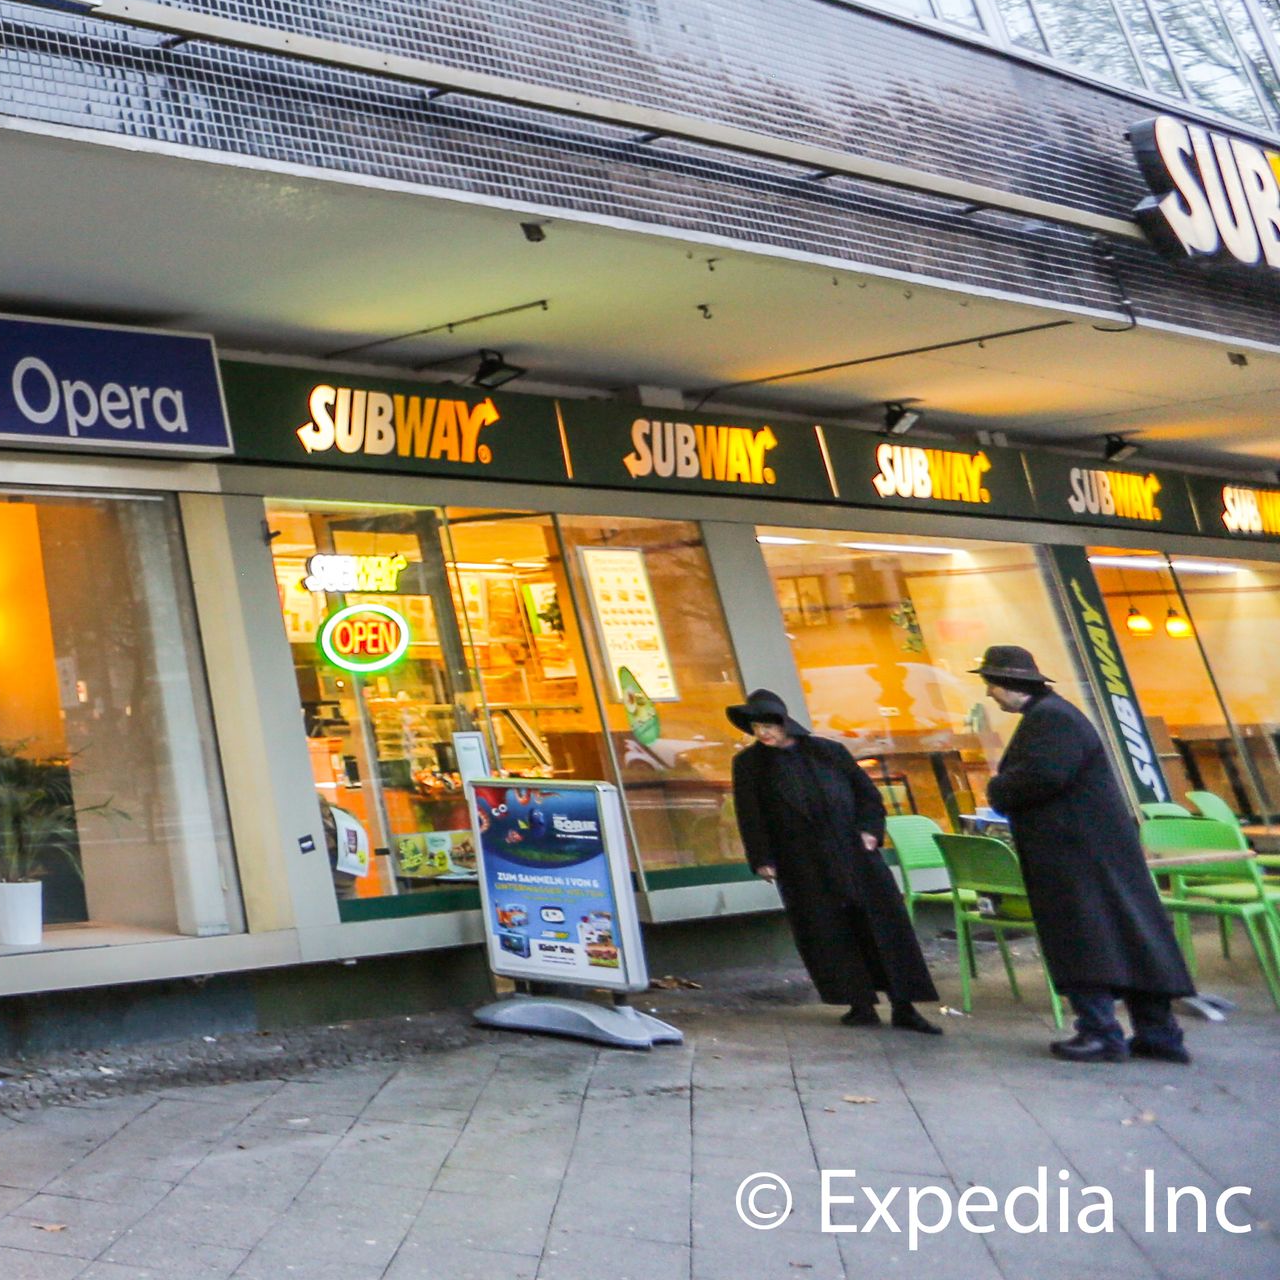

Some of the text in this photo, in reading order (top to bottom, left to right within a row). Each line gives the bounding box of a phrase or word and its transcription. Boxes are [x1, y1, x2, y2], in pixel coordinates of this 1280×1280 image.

[1157, 114, 1280, 269] SUB
[11, 355, 191, 436] Opera
[296, 384, 501, 465] SUBWAY
[622, 418, 779, 485] SUBWAY
[872, 443, 992, 504] SUBWAY
[1067, 467, 1162, 521] SUBWAY
[335, 620, 397, 656] OPEN
[1070, 577, 1166, 803] SUBWAY
